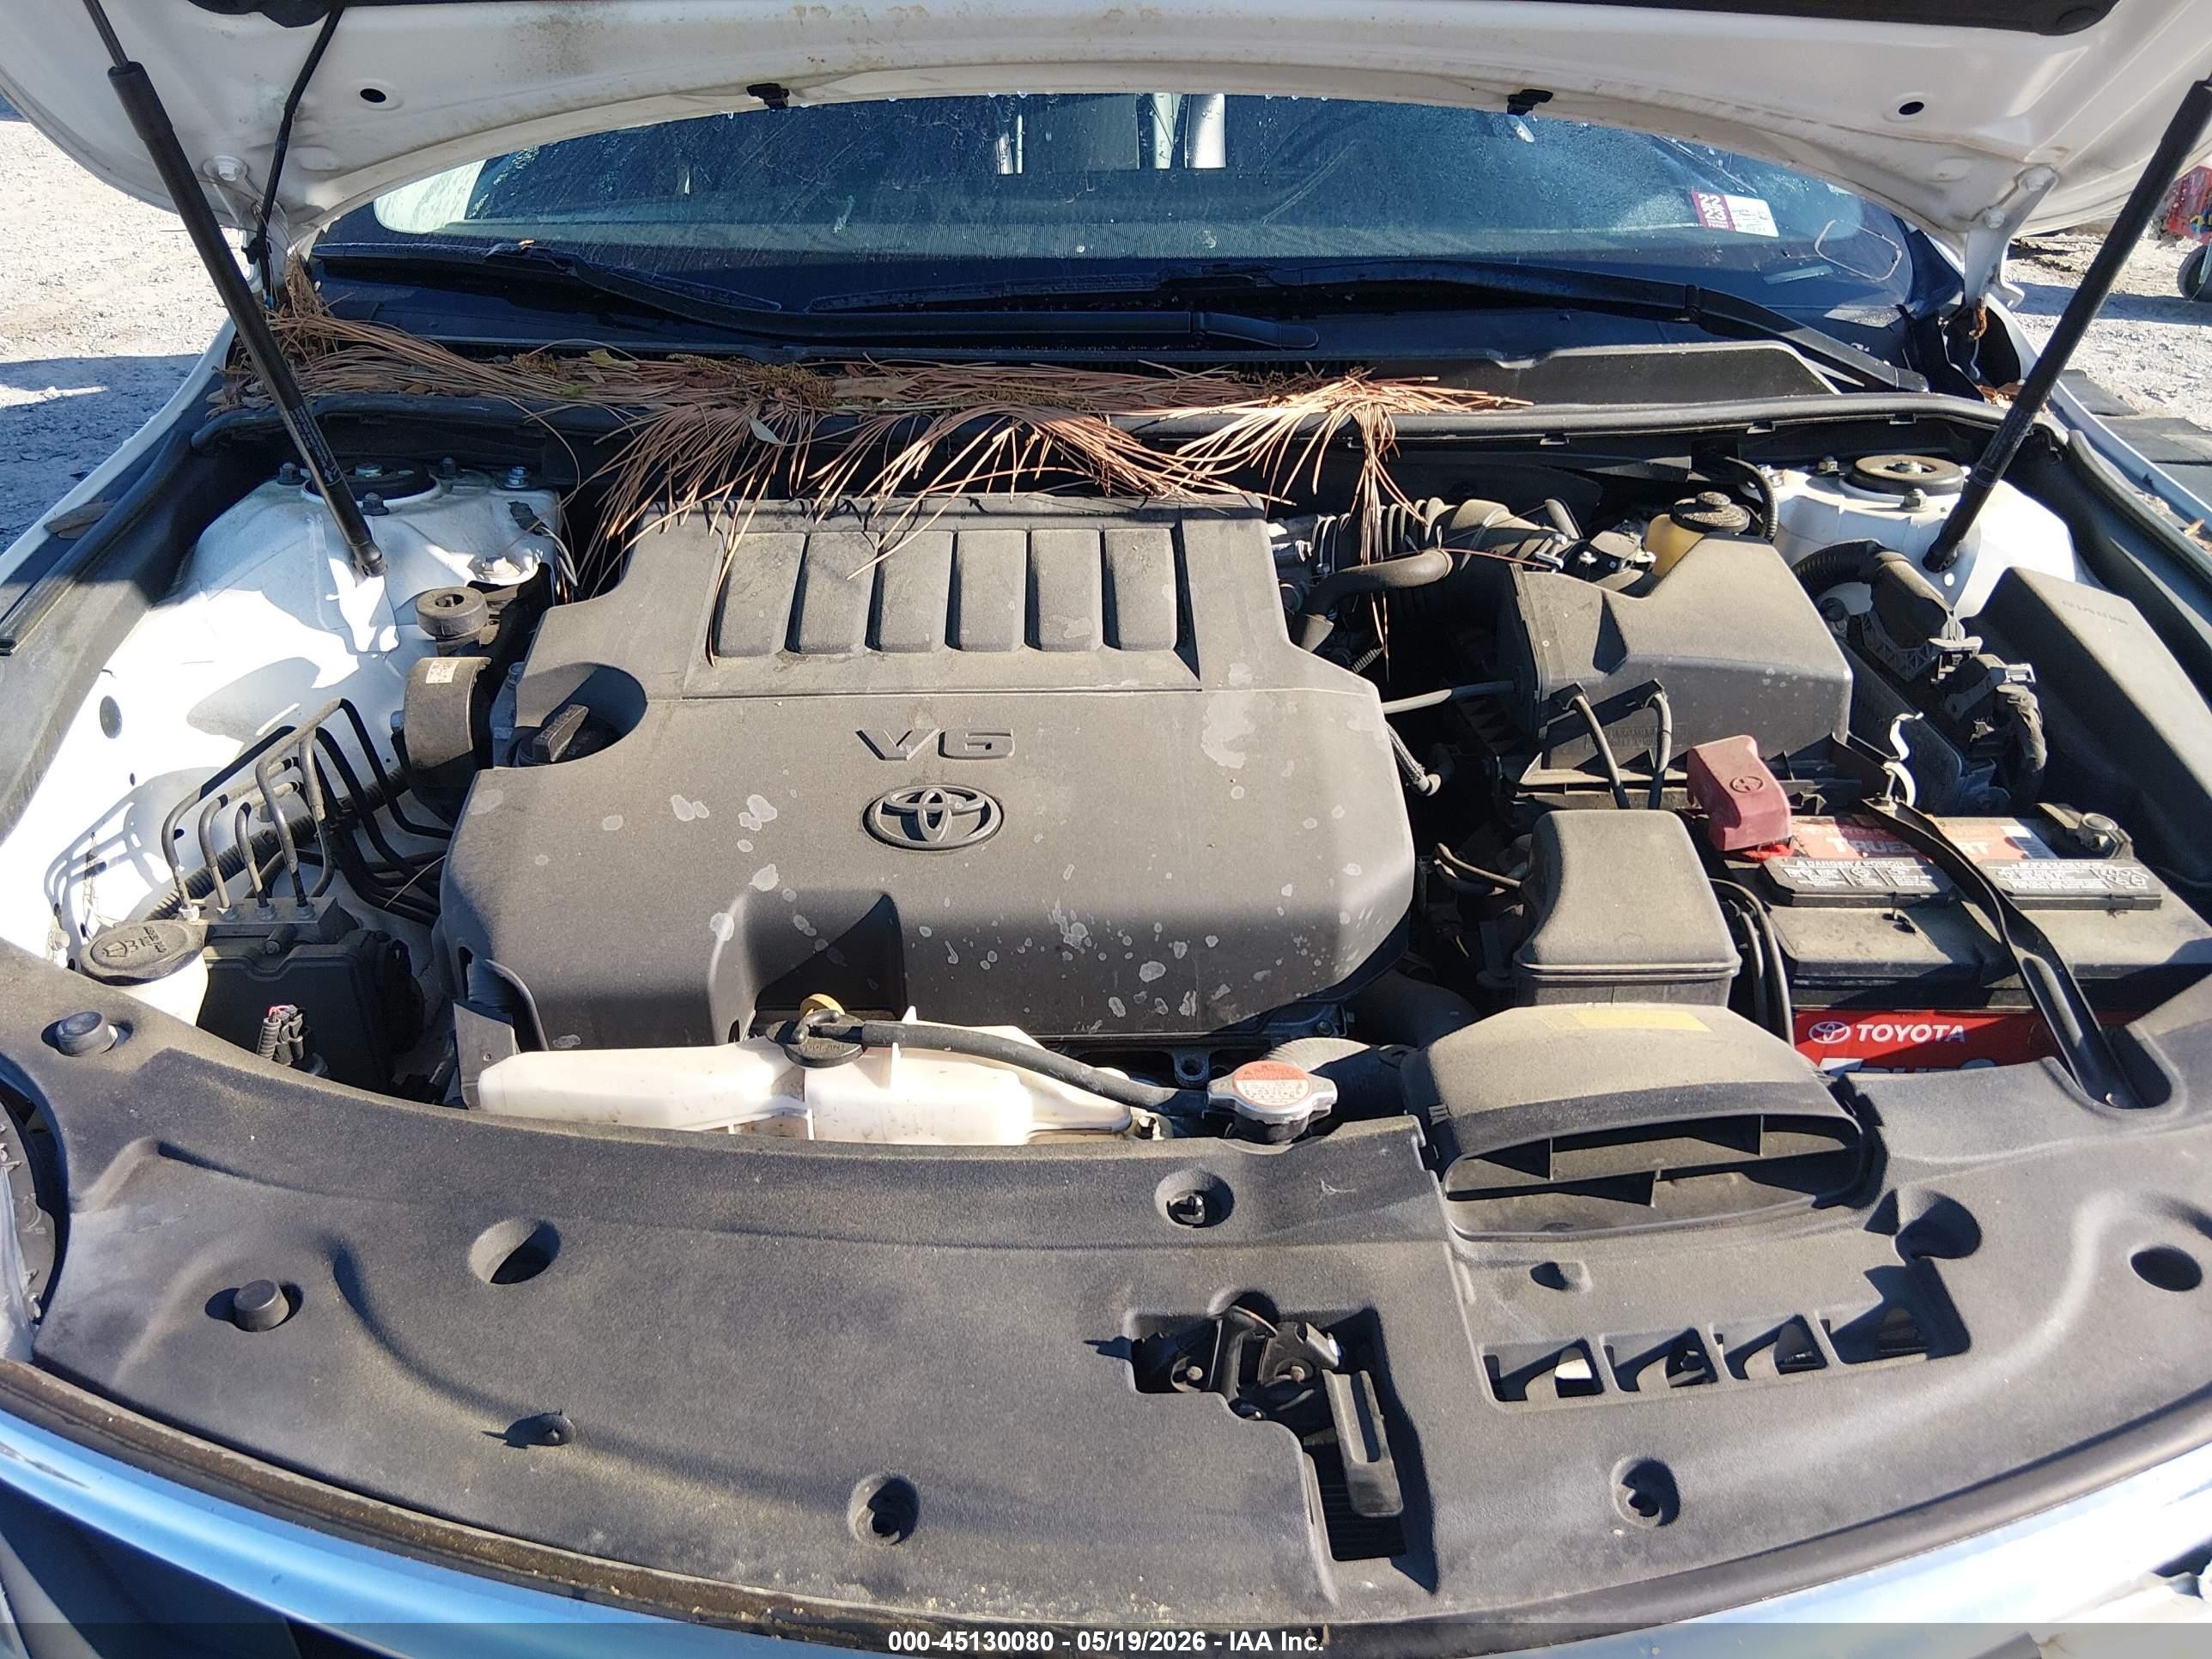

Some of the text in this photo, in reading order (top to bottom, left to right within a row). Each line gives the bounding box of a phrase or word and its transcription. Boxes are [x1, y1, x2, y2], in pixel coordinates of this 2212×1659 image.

[1698, 194, 1723, 208] 22
[1703, 208, 1727, 221] 23
[855, 728, 1016, 761] V6
[1856, 1024, 1966, 1043] TOYOTA
